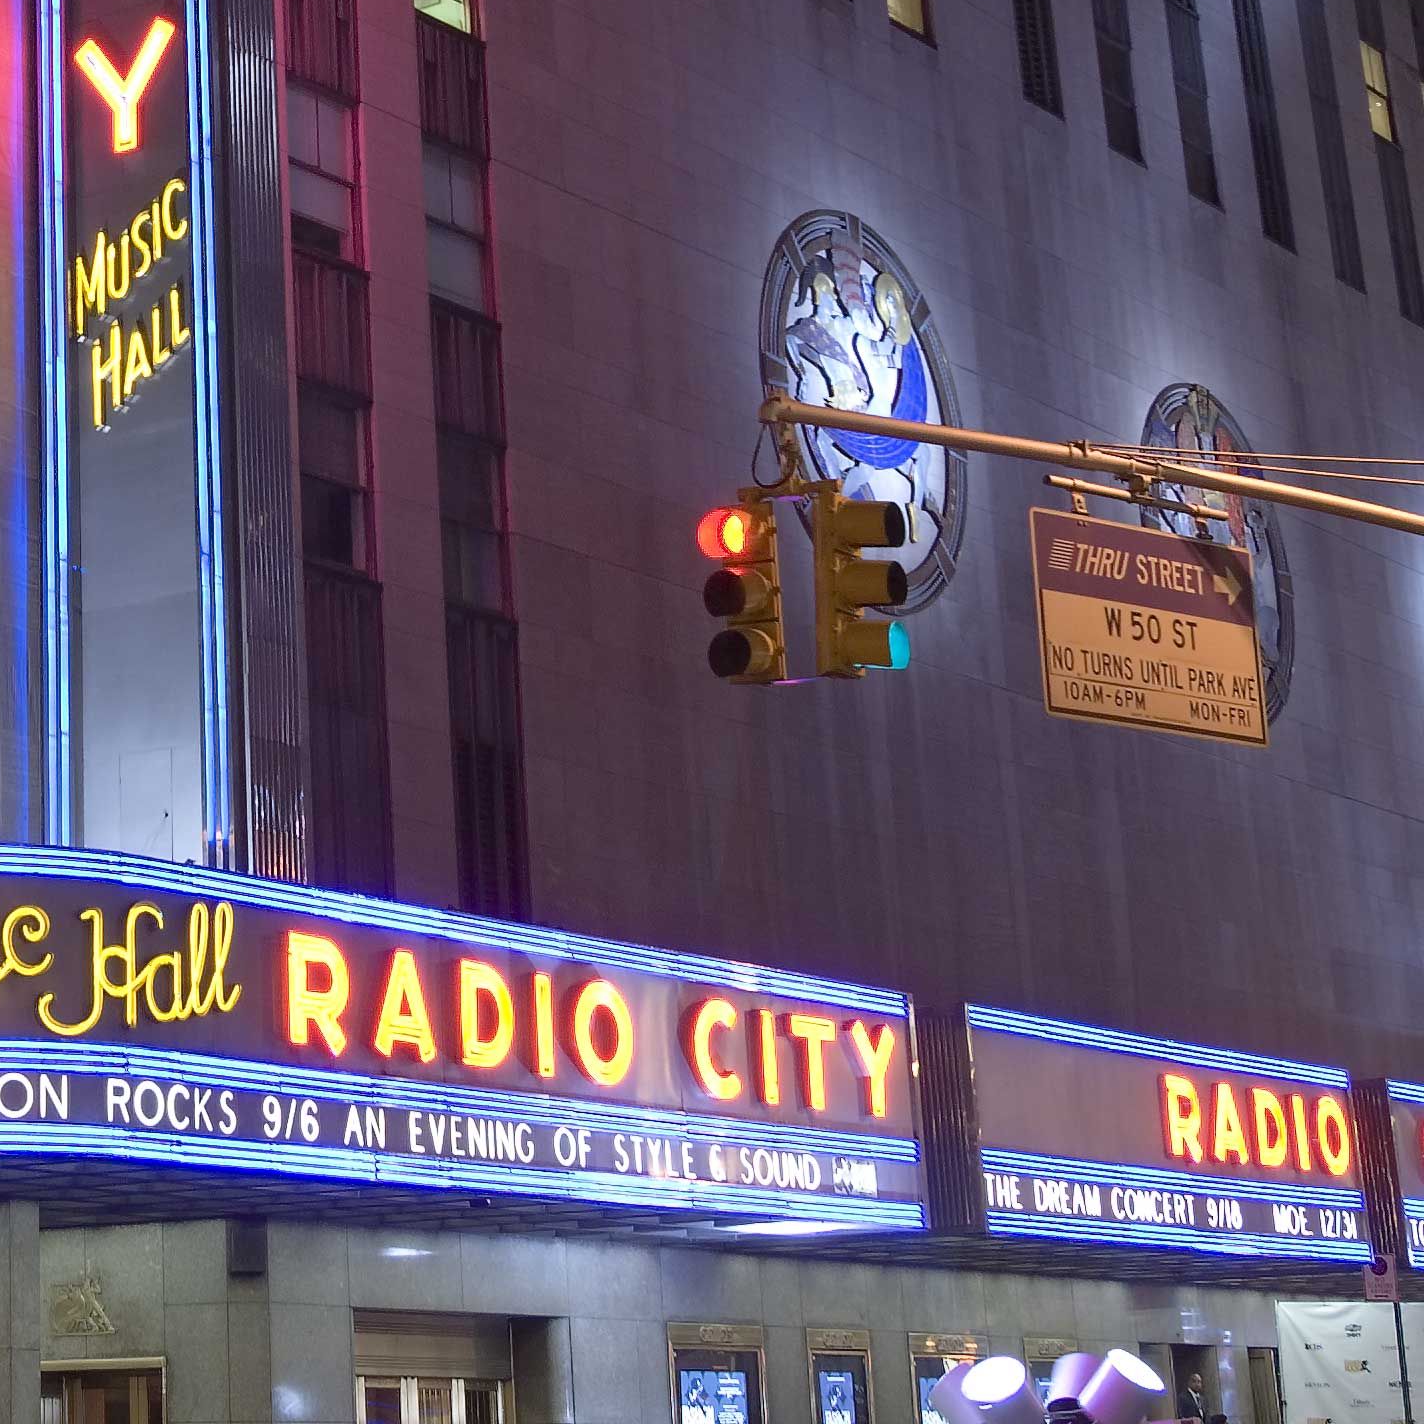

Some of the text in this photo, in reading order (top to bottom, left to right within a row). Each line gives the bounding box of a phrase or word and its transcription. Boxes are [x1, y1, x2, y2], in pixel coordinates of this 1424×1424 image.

[76, 178, 189, 338] MUSIC
[93, 287, 191, 428] HALL
[1075, 543, 1204, 595] THRU STREET
[1051, 644, 1257, 702] NO TURNS UNTIL PARK AVE
[1104, 607, 1197, 650] W 50 ST
[1063, 680, 1146, 710] 10AM-6PM
[1190, 700, 1251, 728] MON-FRI
[38, 901, 241, 1035] Hall
[286, 928, 895, 1119] RADIO CITY
[107, 1077, 237, 1135] ROCKS
[263, 1095, 320, 1142] 9/6
[344, 1105, 386, 1149] AN
[409, 1110, 535, 1164] EVENING
[553, 1126, 592, 1168] OF
[613, 1133, 697, 1180] STYLE
[739, 1146, 822, 1191] SOUND
[1162, 1072, 1350, 1176] RADIO
[983, 1172, 1024, 1210] THE
[1033, 1178, 1102, 1217] DREAM
[1110, 1186, 1195, 1226] CONCERT
